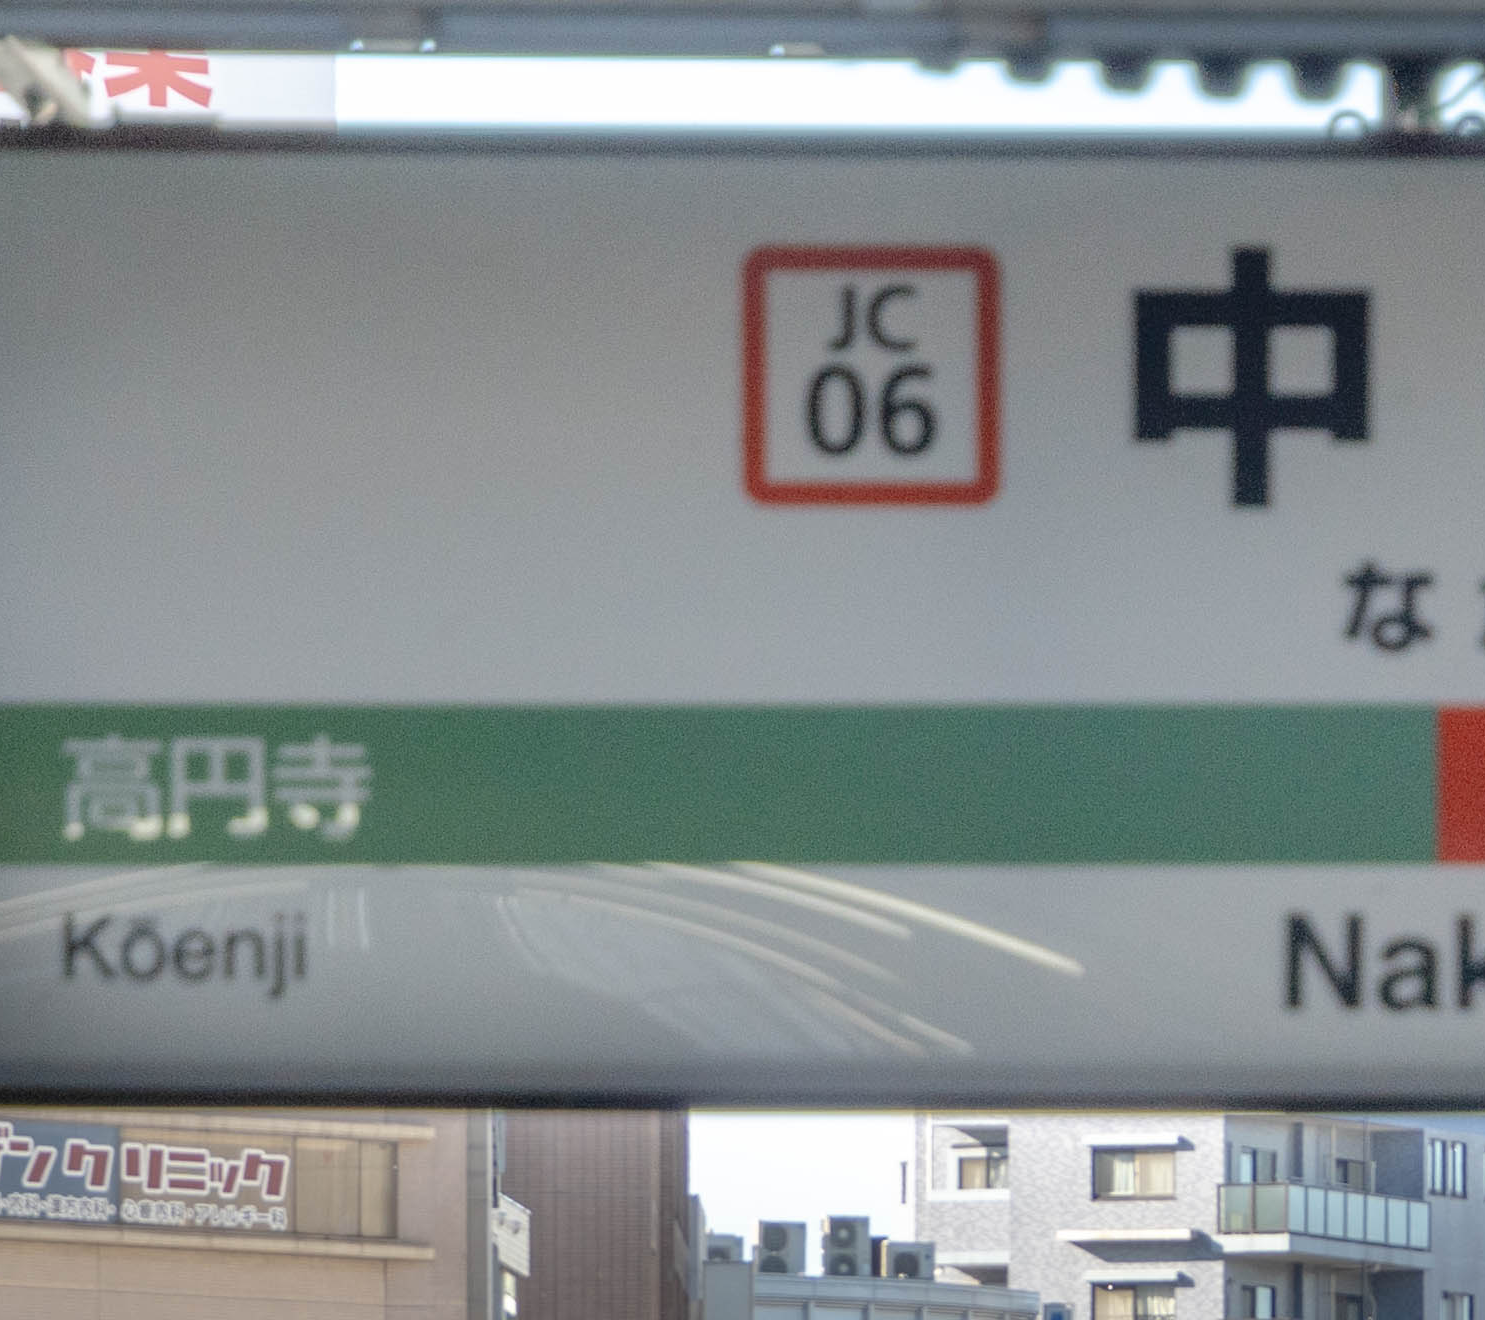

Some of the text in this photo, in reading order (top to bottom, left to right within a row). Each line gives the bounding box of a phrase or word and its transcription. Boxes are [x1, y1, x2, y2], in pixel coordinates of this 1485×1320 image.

[829, 284, 920, 353] JC
[806, 367, 938, 458] 06
[63, 733, 374, 842] 高円寺
